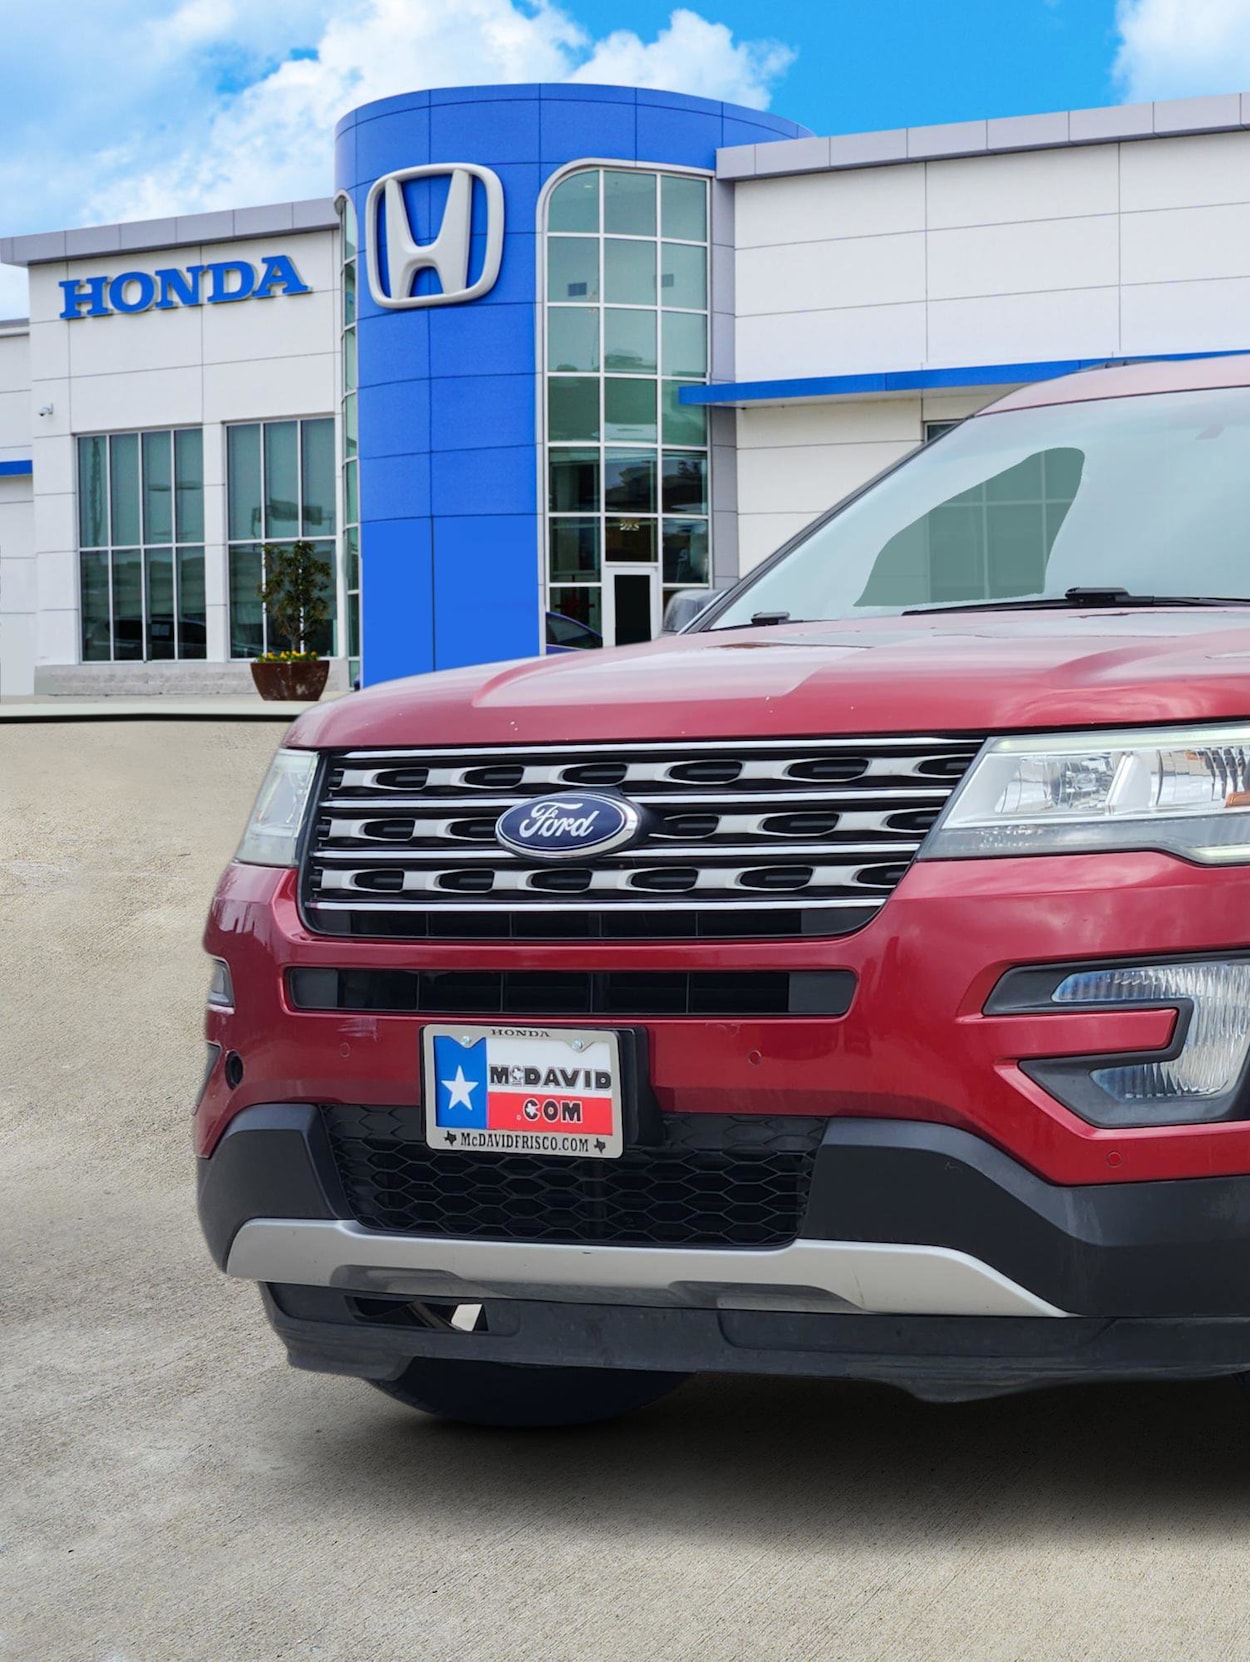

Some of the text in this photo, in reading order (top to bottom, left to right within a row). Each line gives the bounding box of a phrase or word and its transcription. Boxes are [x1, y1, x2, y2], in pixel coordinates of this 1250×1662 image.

[58, 255, 311, 320] HONDA
[519, 801, 600, 839] Ford
[491, 1028, 551, 1038] HONDA
[460, 1132, 590, 1153] McDAVIDFRISCO.COM
